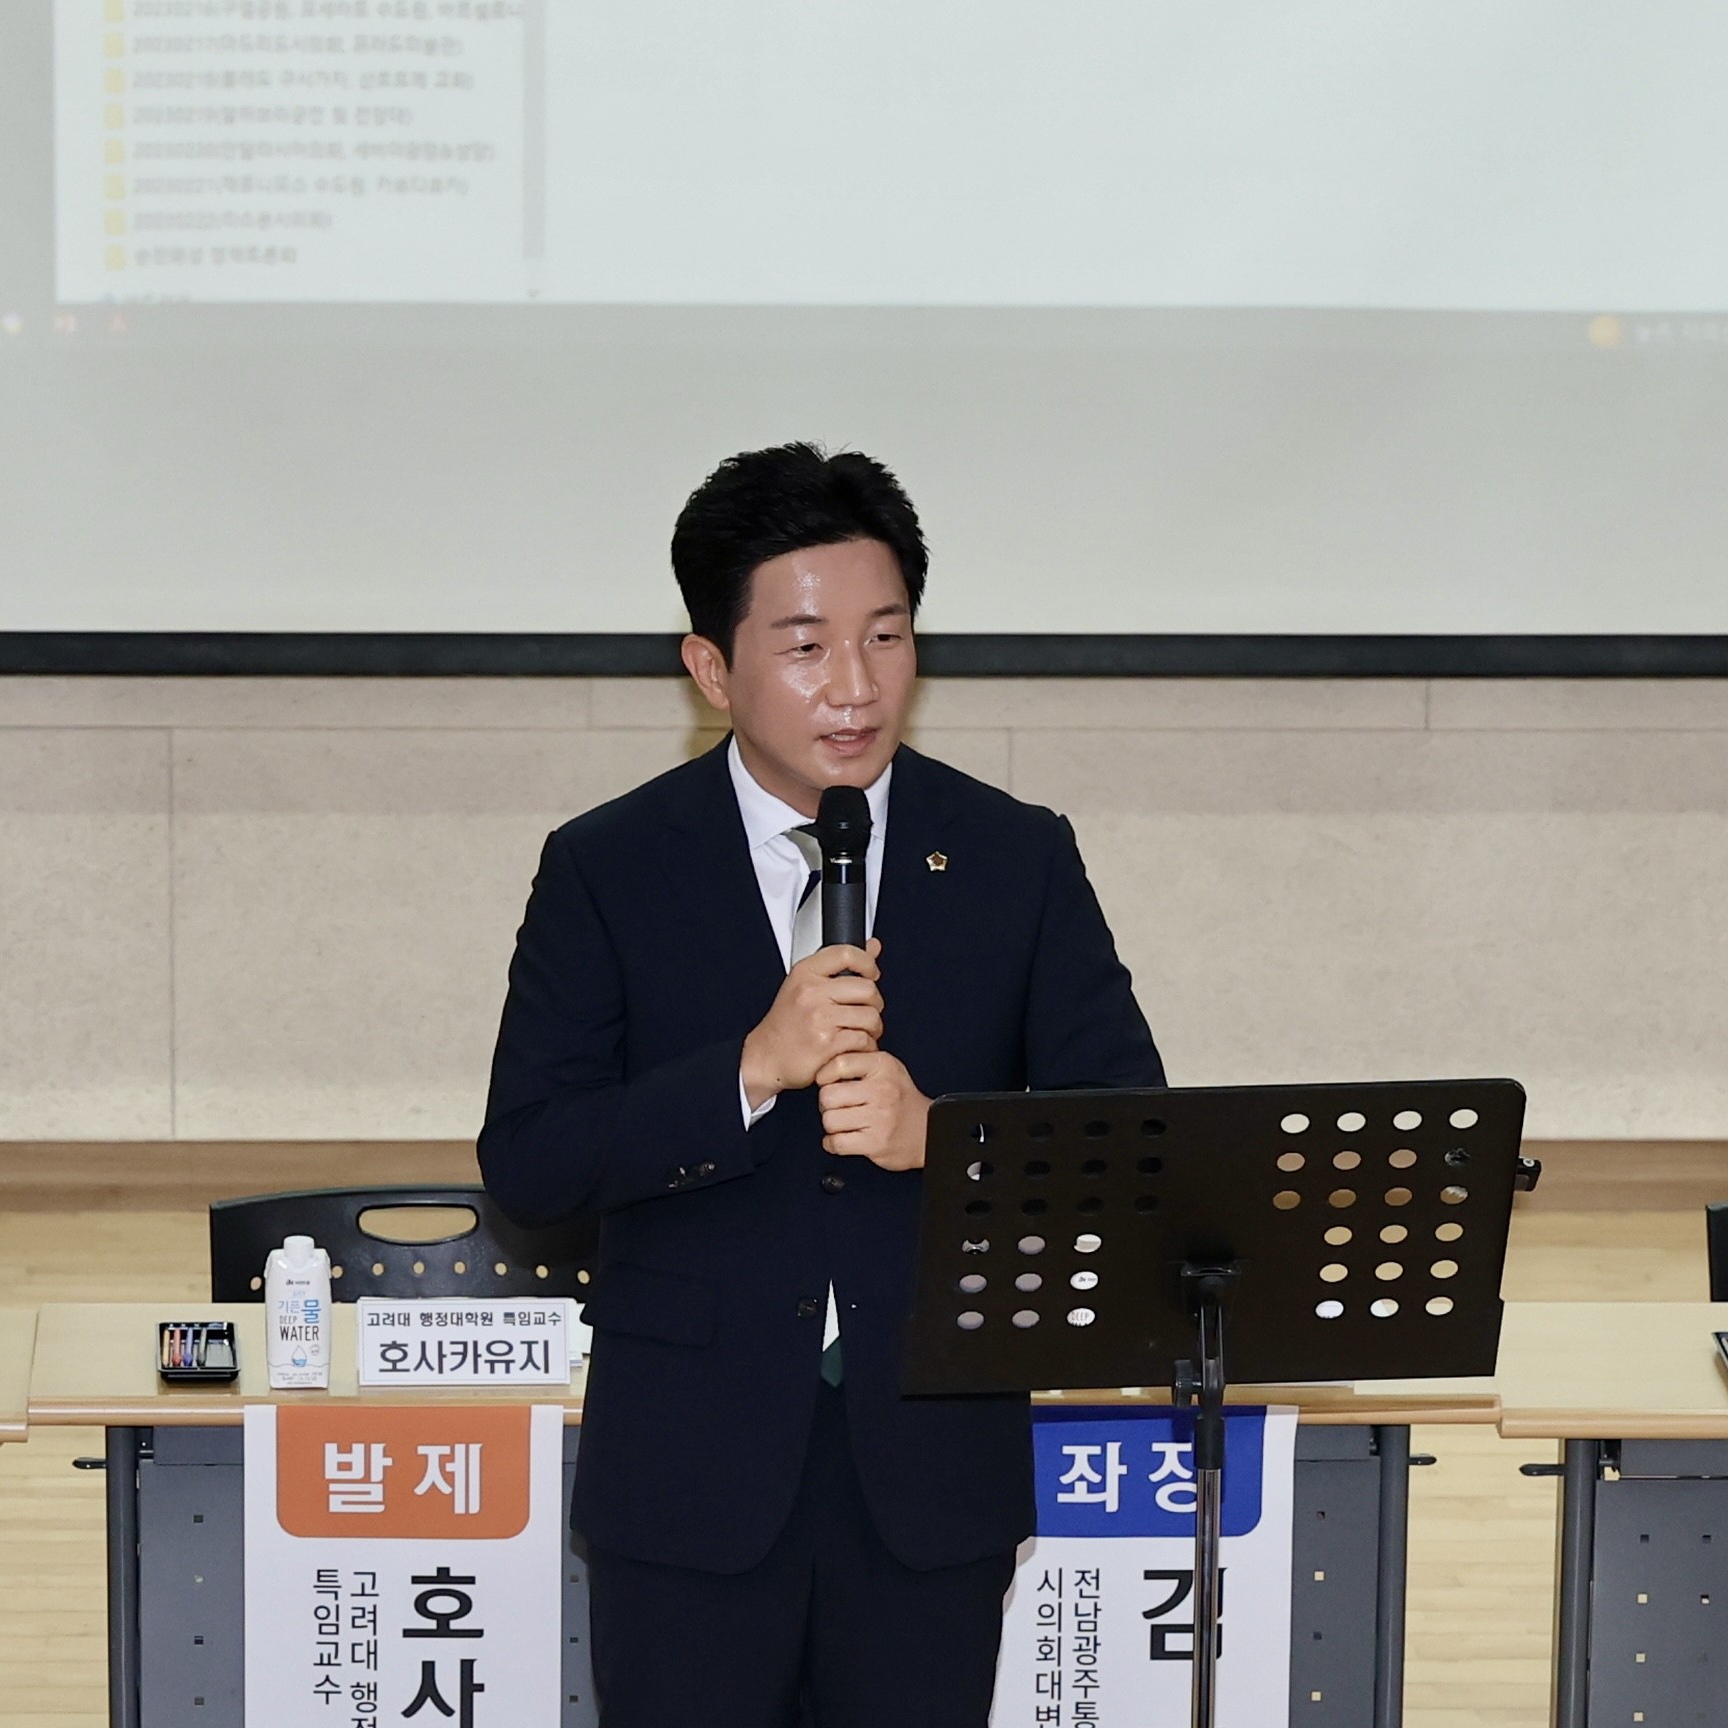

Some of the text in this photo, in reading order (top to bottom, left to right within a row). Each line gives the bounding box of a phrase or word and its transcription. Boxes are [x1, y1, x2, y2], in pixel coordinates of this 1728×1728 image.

[279, 1315, 298, 1324] DEEP
[367, 1311, 562, 1327] 고려대 행정대학원 특임교수
[279, 1325, 319, 1342] WATER
[378, 1339, 550, 1375] 호사카유지
[350, 1571, 380, 1671] 고려대
[312, 1569, 342, 1705] 특임교수
